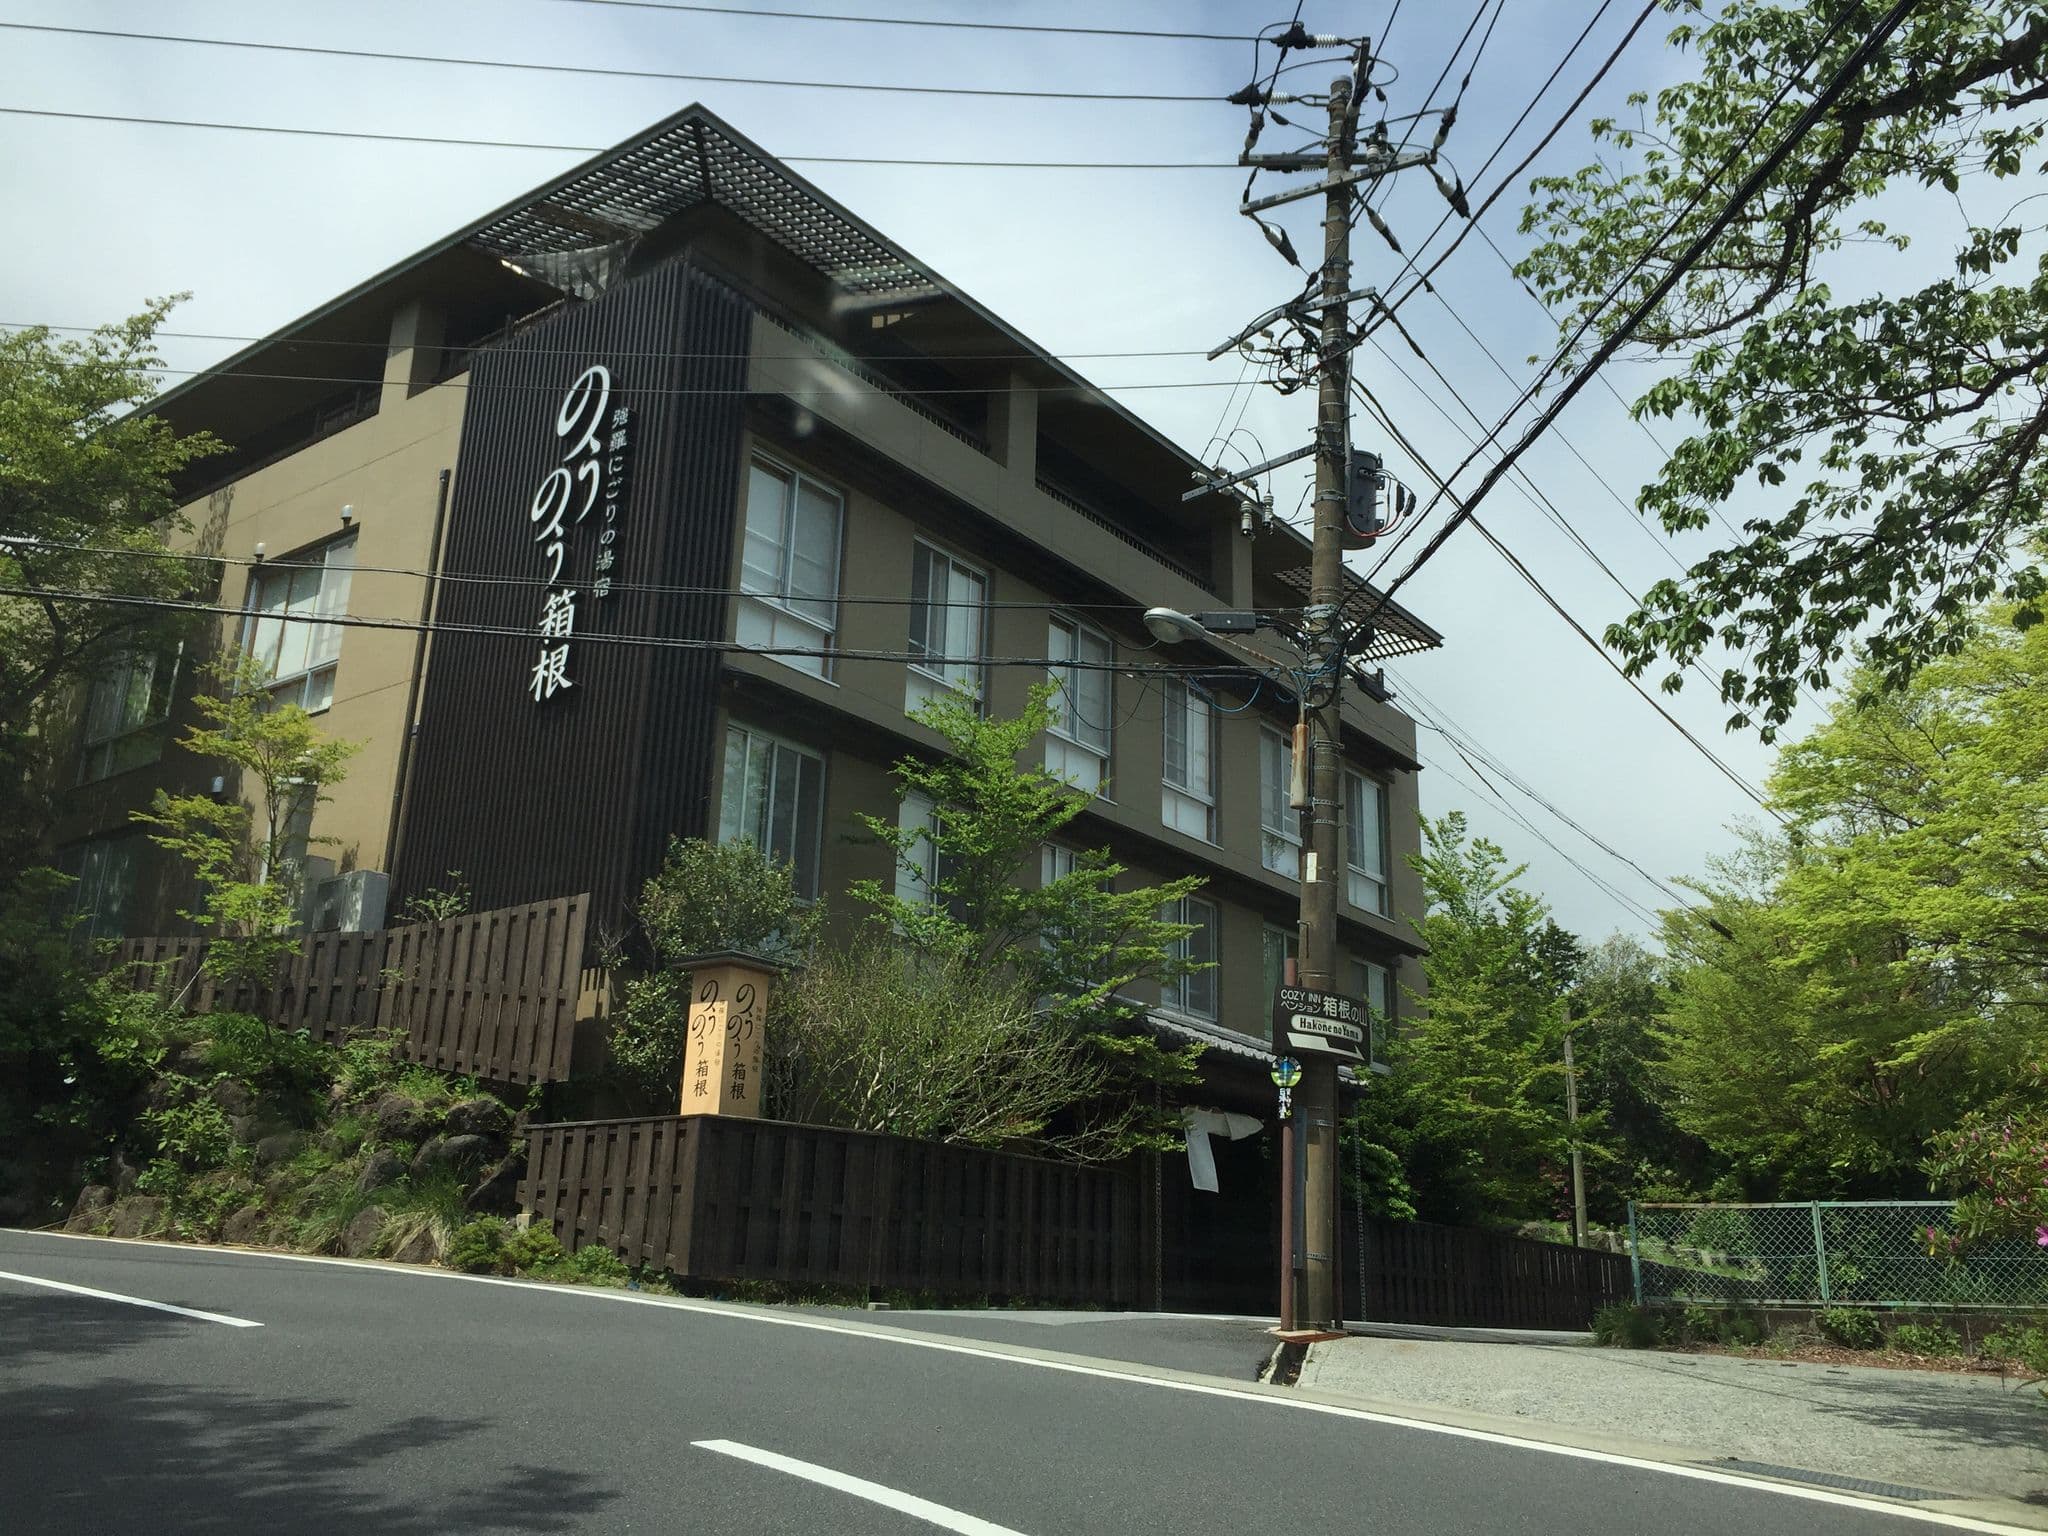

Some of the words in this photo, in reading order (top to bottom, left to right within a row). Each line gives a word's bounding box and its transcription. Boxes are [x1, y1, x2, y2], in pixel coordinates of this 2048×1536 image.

[593, 407, 629, 599] 強羅にごりの湯宿
[1280, 989, 1306, 1001] COZY
[1308, 993, 1322, 1004] INN
[1280, 1001, 1322, 1014] ペンション
[1323, 995, 1368, 1026] 箱根の山
[1299, 1017, 1333, 1033] Hakone
